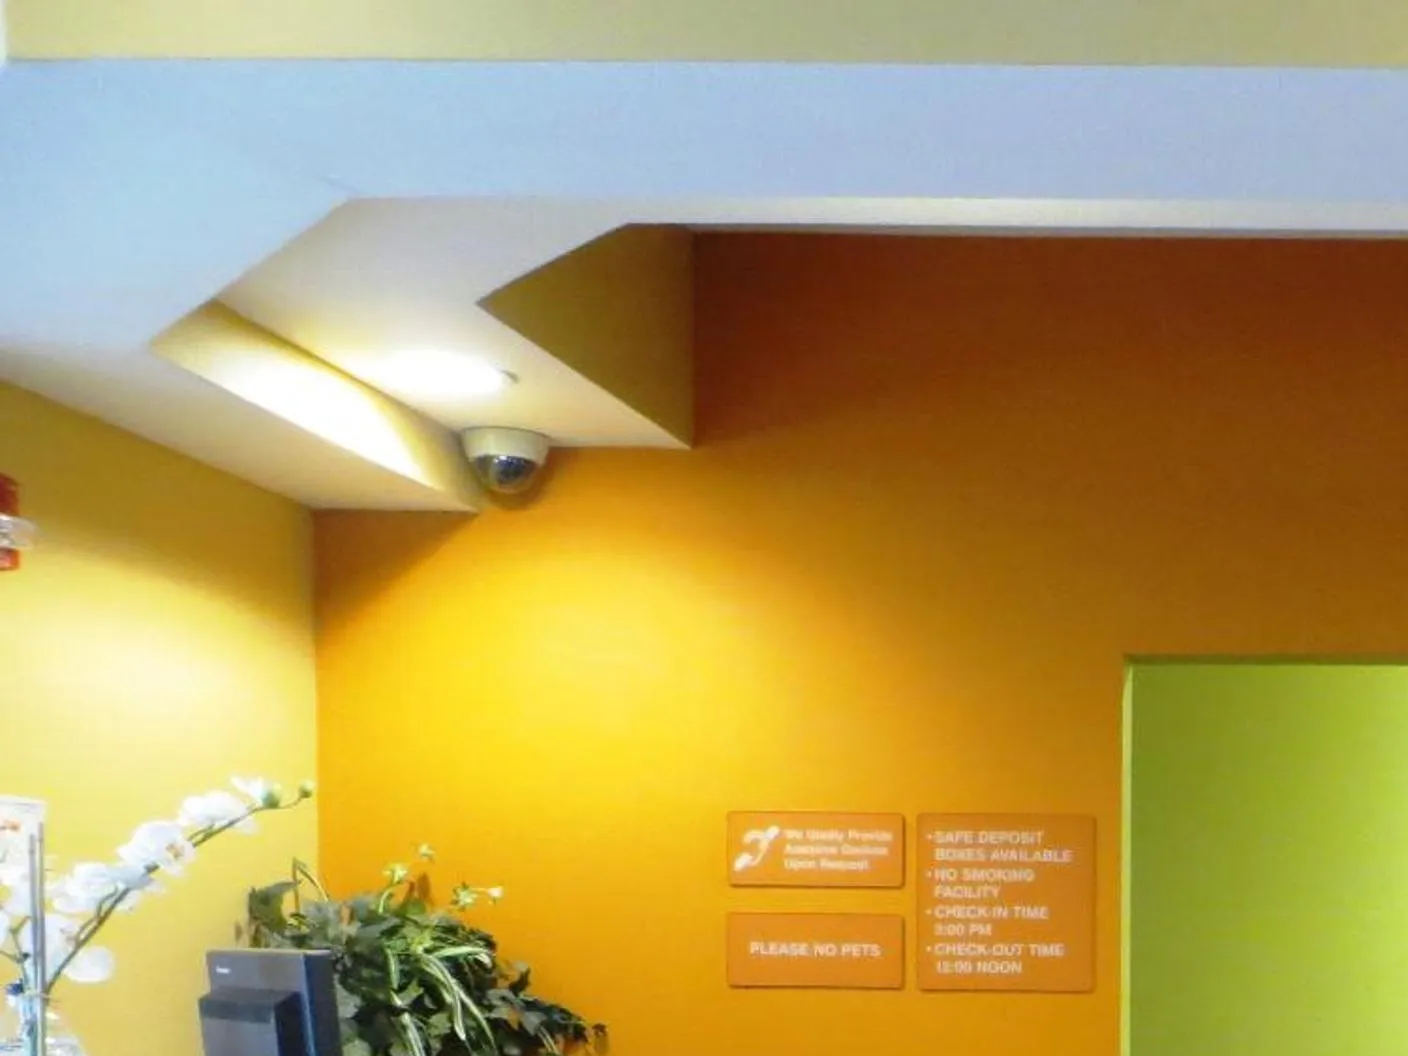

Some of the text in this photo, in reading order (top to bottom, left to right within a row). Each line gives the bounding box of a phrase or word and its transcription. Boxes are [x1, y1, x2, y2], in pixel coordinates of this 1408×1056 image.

[934, 830, 1044, 845] SAFE DEPOSIT
[989, 848, 1073, 863] AVAILABLE
[934, 867, 958, 881] NO
[934, 885, 1001, 899] FACILITY
[1013, 905, 1050, 920] TIME
[968, 923, 993, 936] PM
[750, 940, 882, 958] PLEASE NO PETS
[1028, 943, 1066, 958] TIME
[977, 960, 1023, 975] NOON
